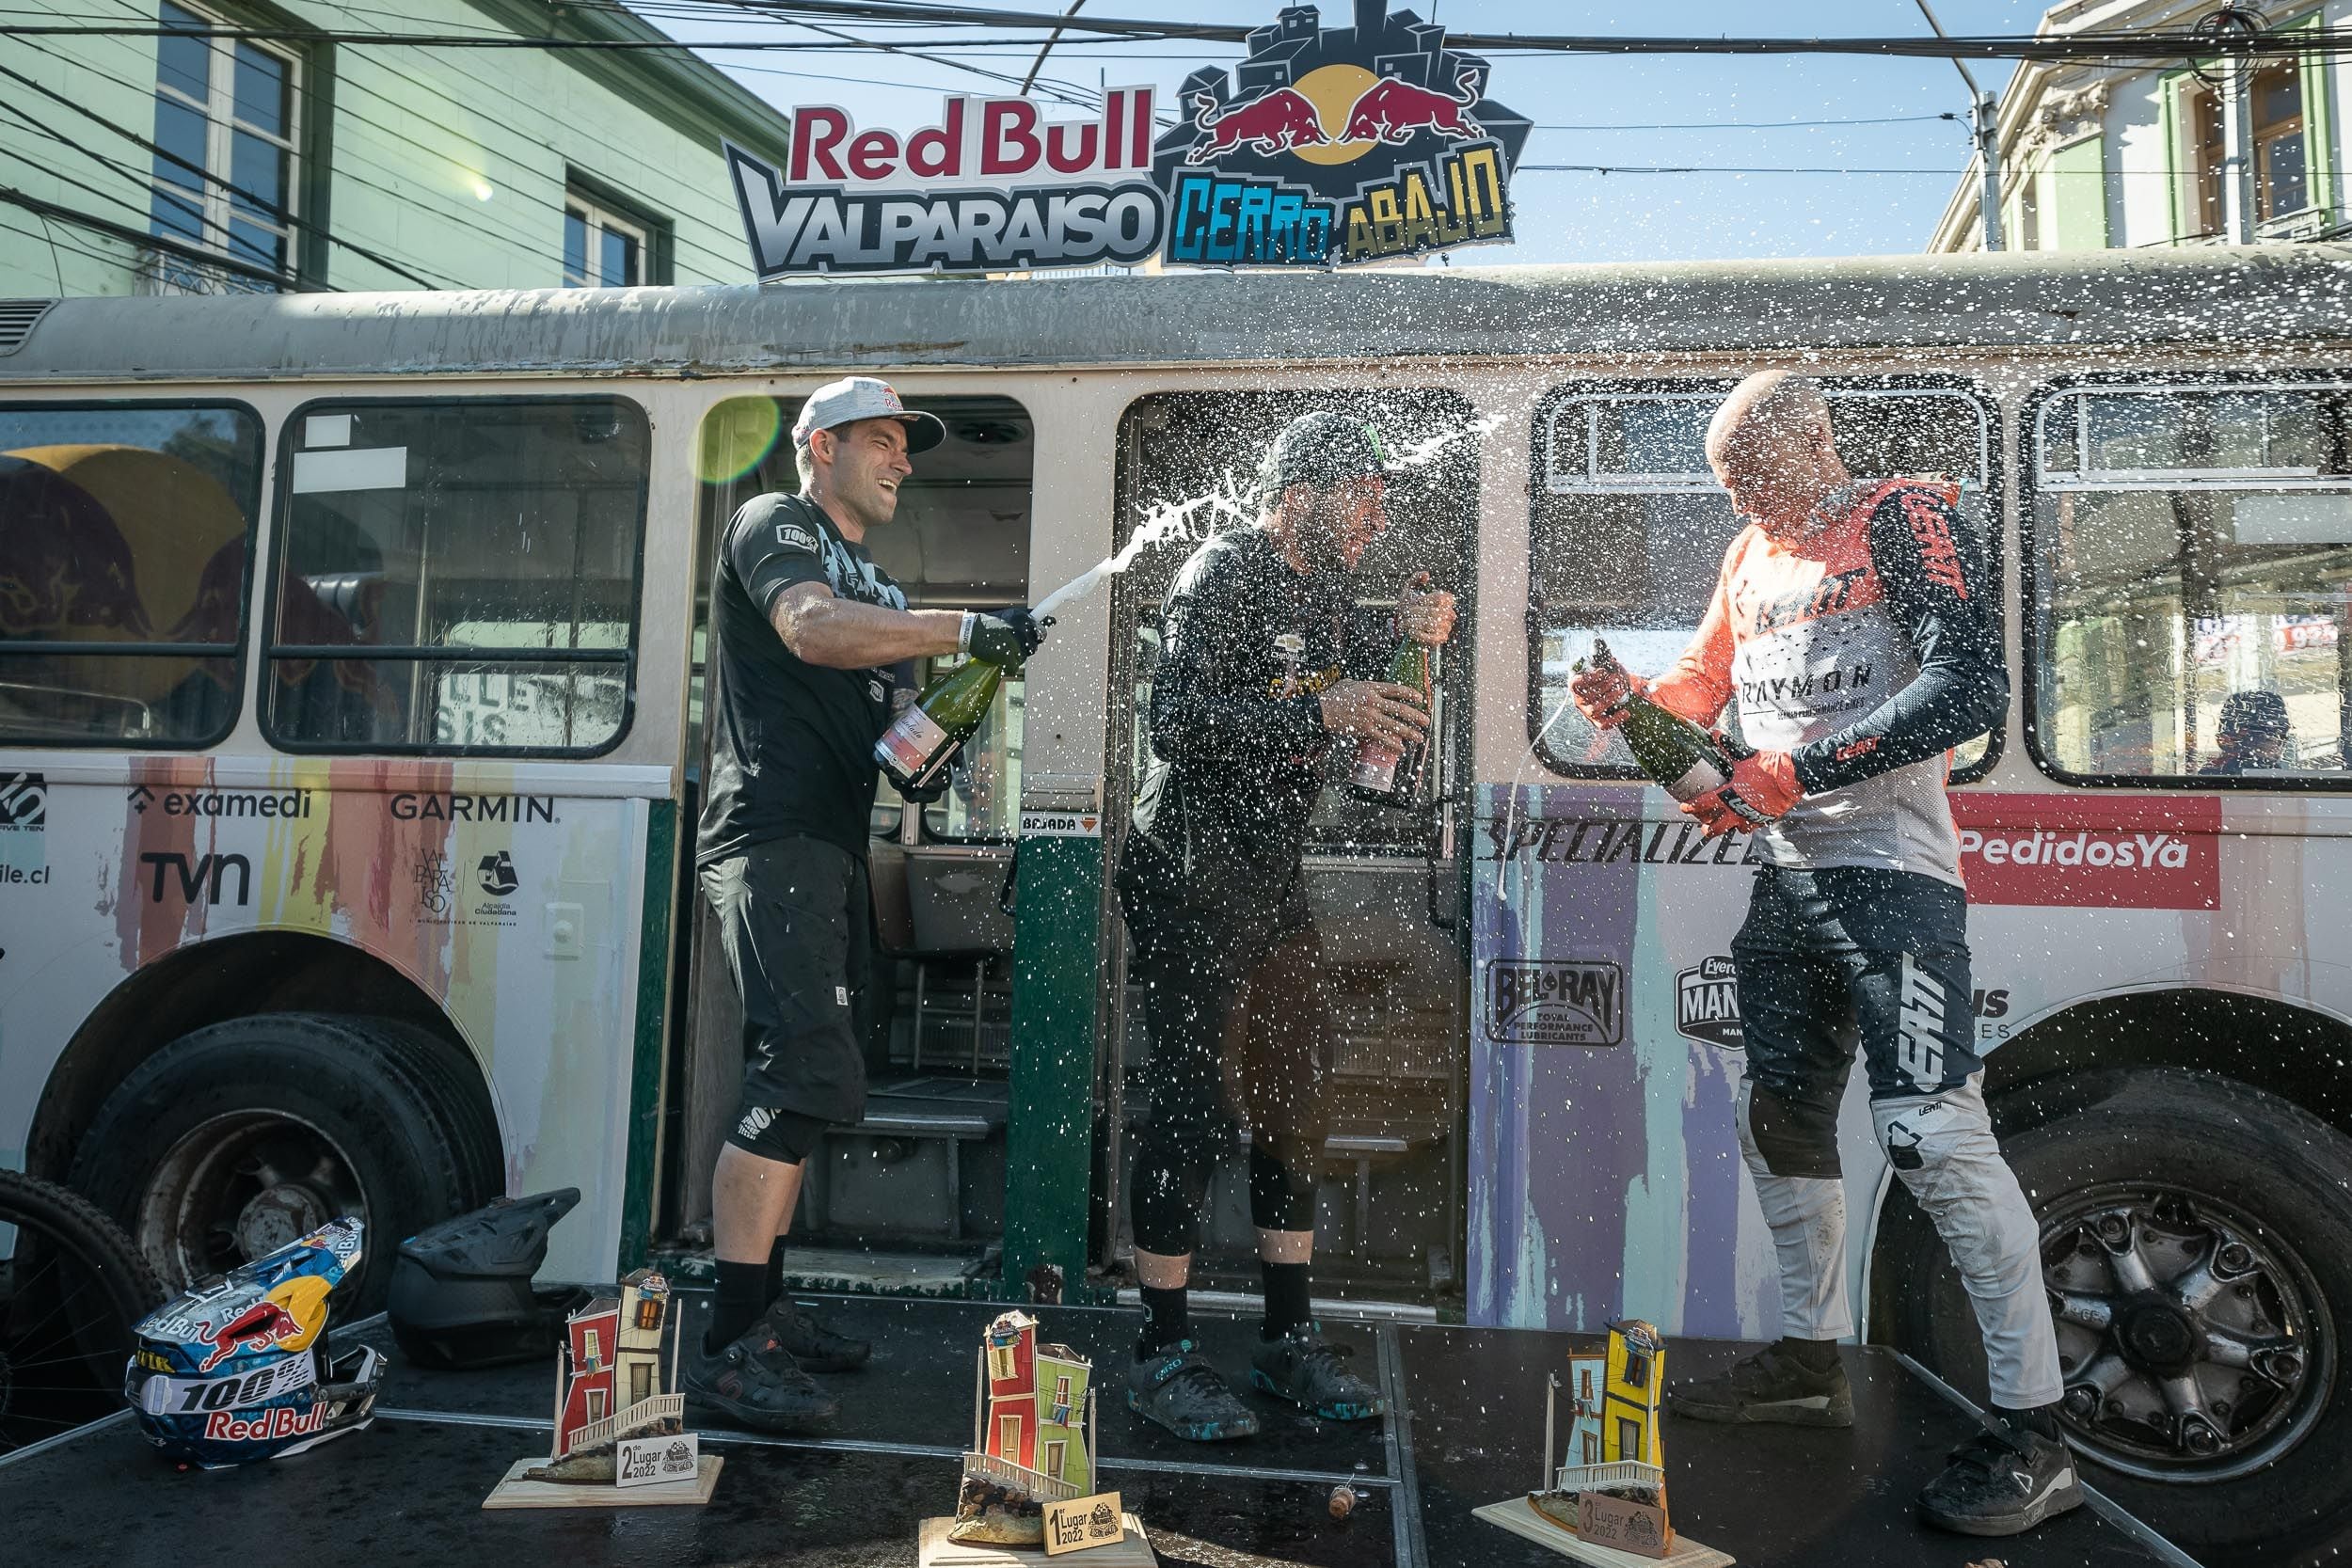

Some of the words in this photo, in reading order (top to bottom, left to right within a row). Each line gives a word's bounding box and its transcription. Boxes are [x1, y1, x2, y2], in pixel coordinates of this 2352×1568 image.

[790, 97, 965, 181] Red
[980, 88, 1152, 176] Bull
[737, 158, 1156, 268] VALPARAISO
[1174, 178, 1330, 260] CERRO
[1347, 149, 1504, 260] ABAJO
[1742, 663, 1872, 704] RAYMON
[164, 788, 311, 818] examedi
[390, 794, 554, 823] GARMIN
[1023, 817, 1076, 831] BAJADA
[1960, 831, 2189, 868] PedidosYa
[1515, 1022, 1594, 1032] PERFORMANCE
[1537, 1013, 1570, 1022] TOTAL
[1520, 1032, 1587, 1041] LUBRICANTS
[1155, 1358, 1183, 1380] GIRO
[182, 1353, 309, 1412] 100%
[204, 1410, 274, 1441] Red
[274, 1402, 328, 1438] Bull
[633, 1451, 661, 1465] Lugar
[633, 1465, 656, 1478] 2022
[1060, 1513, 1088, 1530] Lugar
[1595, 1507, 1625, 1528] Lugar
[1061, 1529, 1084, 1544] 2022
[1594, 1524, 1617, 1540] 2022
